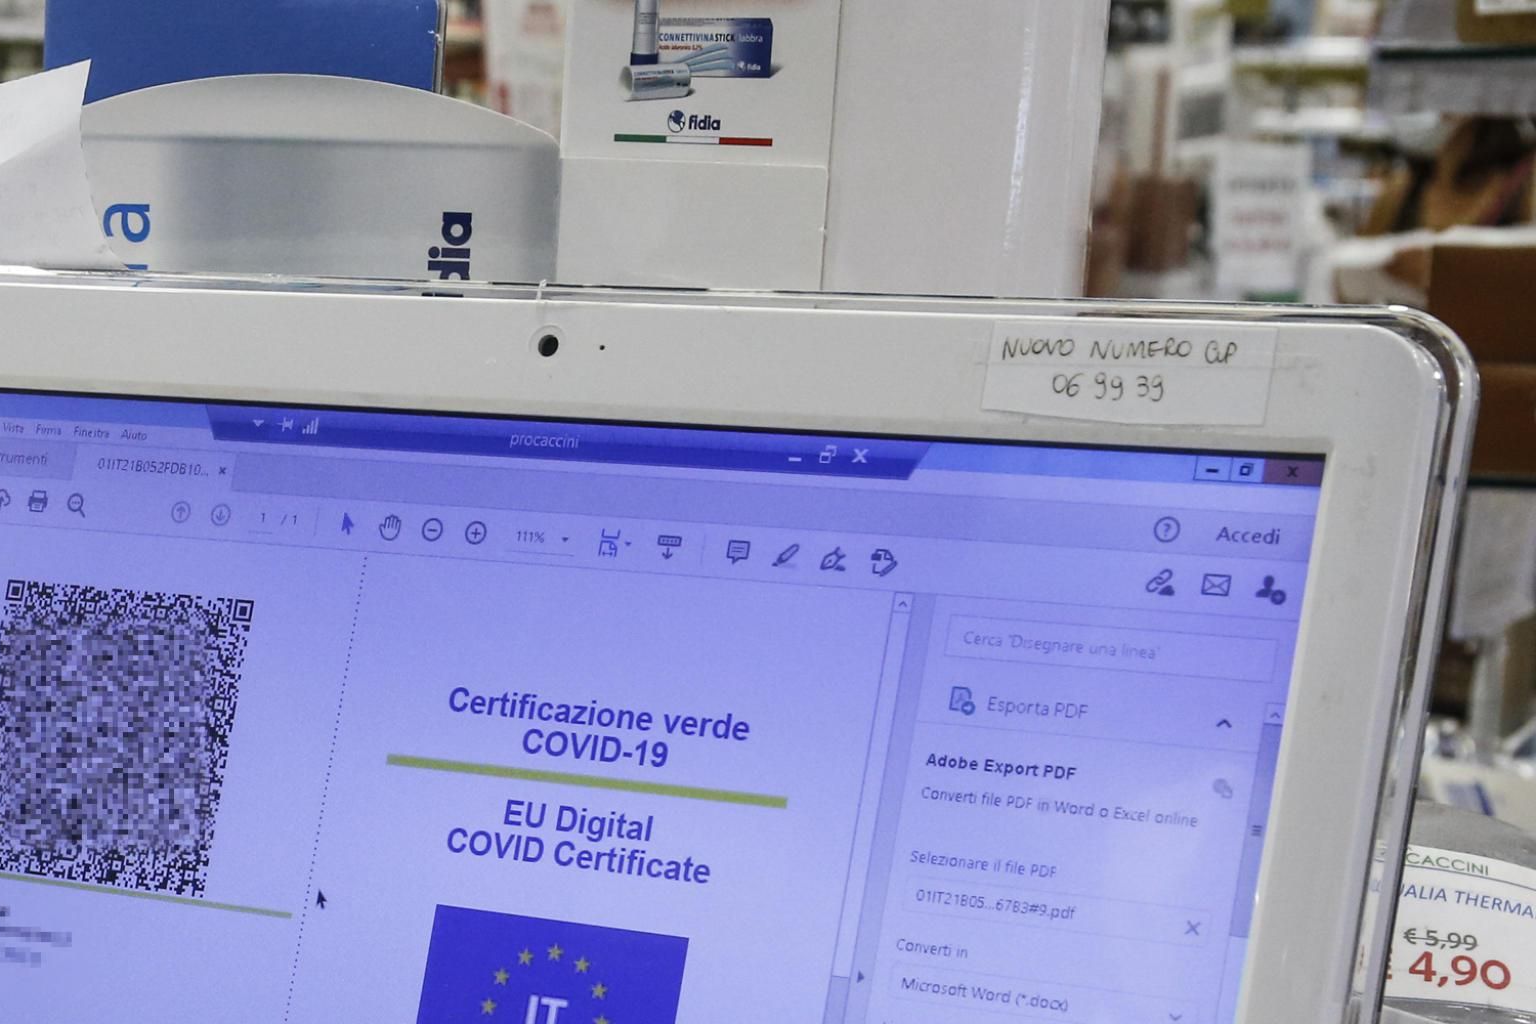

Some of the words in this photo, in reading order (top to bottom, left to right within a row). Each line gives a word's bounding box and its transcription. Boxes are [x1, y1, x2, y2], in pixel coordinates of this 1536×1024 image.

[687, 114, 722, 131] fidia
[1002, 338, 1075, 361] NUOVO
[1090, 336, 1193, 360] NUMERO
[1052, 373, 1083, 398] 06
[1094, 372, 1124, 401] 99
[1136, 374, 1164, 402] 39
[74, 426, 111, 439] Finestra
[121, 429, 148, 441] Aiuto
[509, 431, 580, 450] procaccini
[516, 529, 546, 544] 111%
[1216, 525, 1282, 546] Accedi
[964, 630, 1004, 649] Cerca
[1090, 642, 1117, 657] una
[448, 685, 654, 731] Certificazione
[663, 712, 751, 742] verde
[987, 696, 1050, 720] Esporta
[1053, 701, 1089, 721] PDF
[522, 728, 669, 768] COVID-19
[926, 752, 979, 773] Adobe
[984, 758, 1040, 779] Export
[1043, 764, 1078, 781] PDF
[921, 785, 978, 806] Converti
[981, 791, 1004, 808] file
[1006, 795, 1034, 811] PDF
[1037, 797, 1050, 813] in
[1054, 800, 1095, 817] Word
[1113, 806, 1151, 825] Excel
[1155, 810, 1199, 828] online
[503, 799, 547, 828] EU
[556, 804, 655, 844] Digital
[446, 827, 546, 864] COVID
[553, 840, 712, 885] Certificate
[910, 849, 989, 873] Selezionare
[993, 858, 1002, 873] il
[1005, 859, 1027, 877] file
[1030, 864, 1058, 879] PDF
[1455, 890, 1536, 920] THERMA
[896, 938, 953, 958] Converti
[1425, 929, 1479, 952] 5,99
[1408, 950, 1512, 991] 4,90
[901, 976, 969, 999] Microsoft
[971, 986, 1011, 1005] Word
